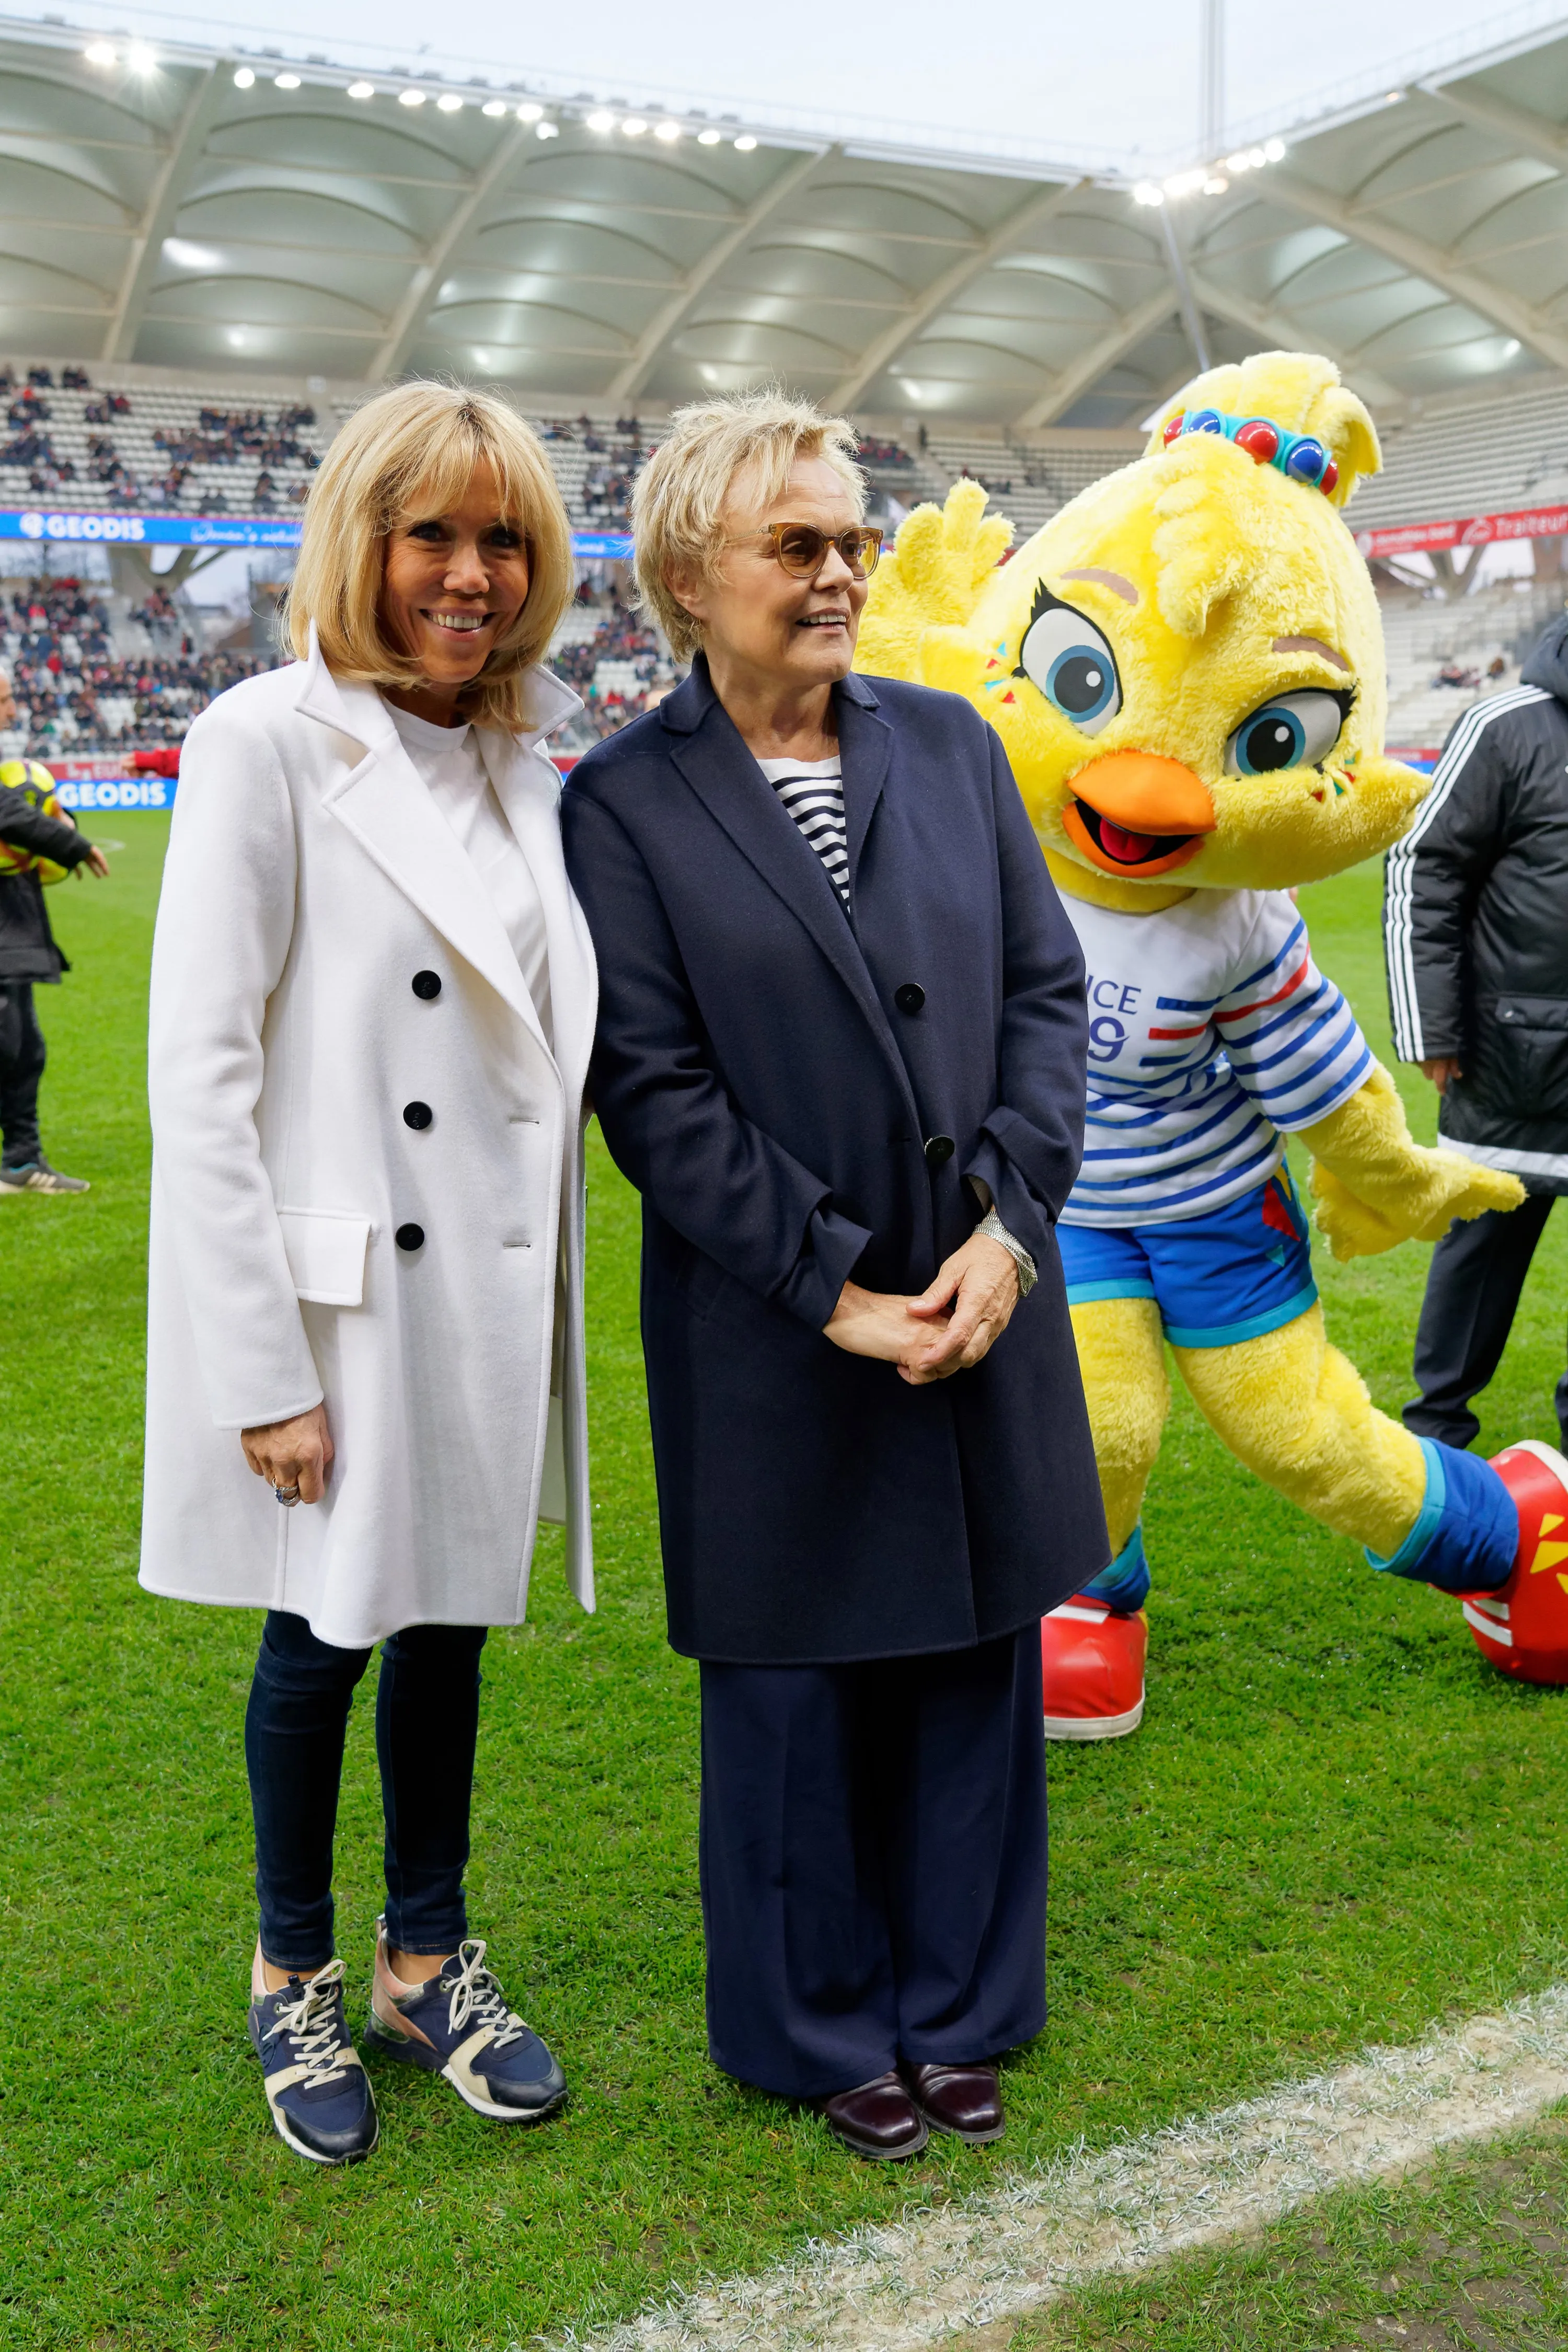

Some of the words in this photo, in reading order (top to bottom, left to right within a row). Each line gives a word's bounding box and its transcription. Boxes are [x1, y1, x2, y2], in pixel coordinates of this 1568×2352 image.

[47, 514, 145, 540] GEODIS
[1495, 513, 1568, 538] Traiteur
[57, 782, 166, 807] GEODIS
